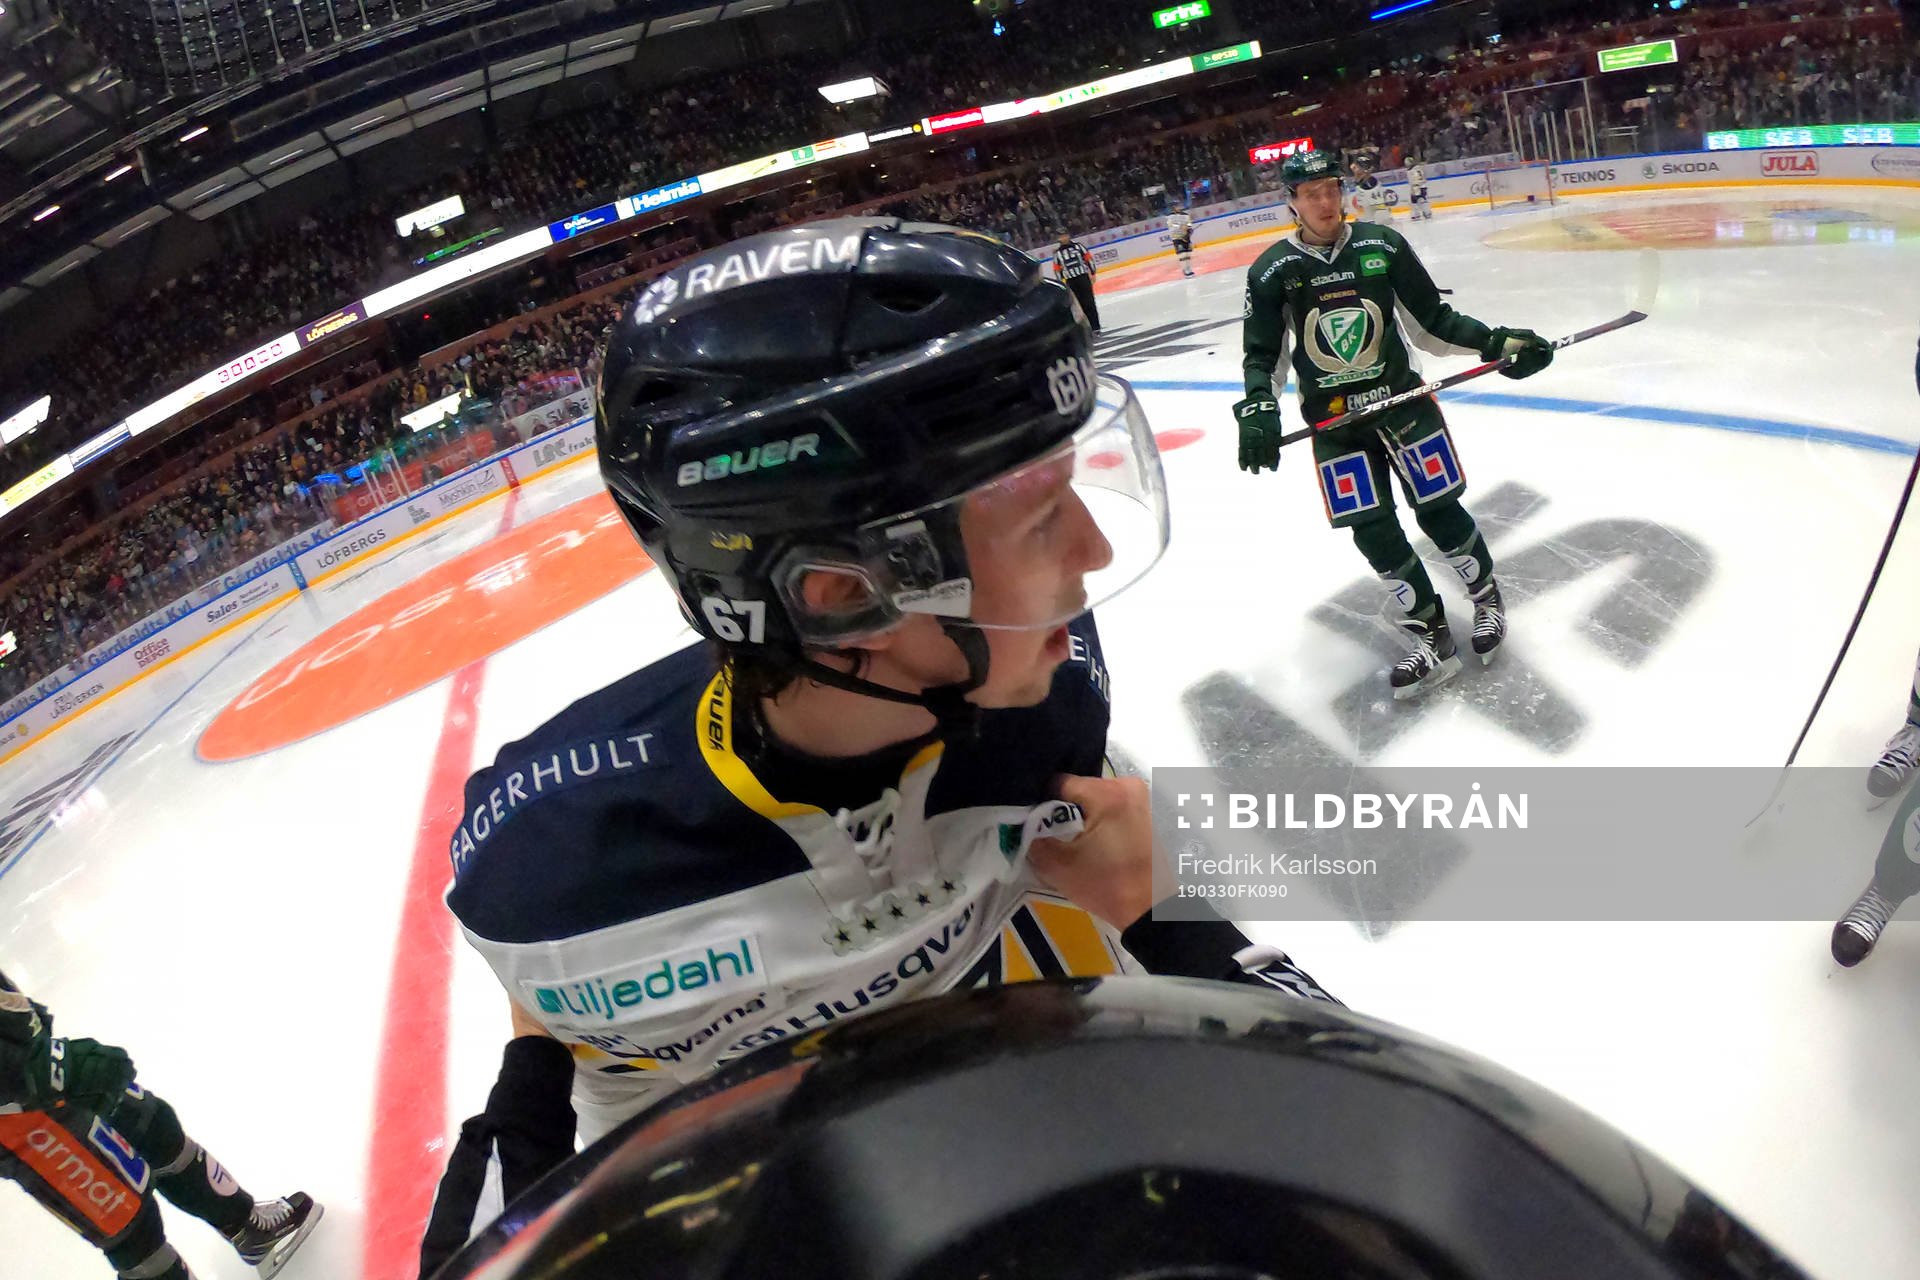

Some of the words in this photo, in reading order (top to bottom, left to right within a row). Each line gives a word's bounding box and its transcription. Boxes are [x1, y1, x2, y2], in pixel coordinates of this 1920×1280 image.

[1707, 132, 1739, 150] EB
[1765, 130, 1813, 146] SEB
[1843, 127, 1894, 144] SEB
[1763, 155, 1816, 172] JULA
[1561, 168, 1616, 184] TEKNOS
[1310, 271, 1355, 287] stadium
[1360, 381, 1443, 415] JETSPEED
[439, 483, 477, 505] Myshkin
[316, 529, 386, 569] LÖFBERGS
[701, 597, 766, 643] 67
[134, 637, 169, 660] Office
[138, 645, 171, 668] DEPOT
[451, 733, 654, 873] FAGERHULT
[560, 938, 755, 1020] Liljedahl
[27, 1128, 127, 1214] armat
